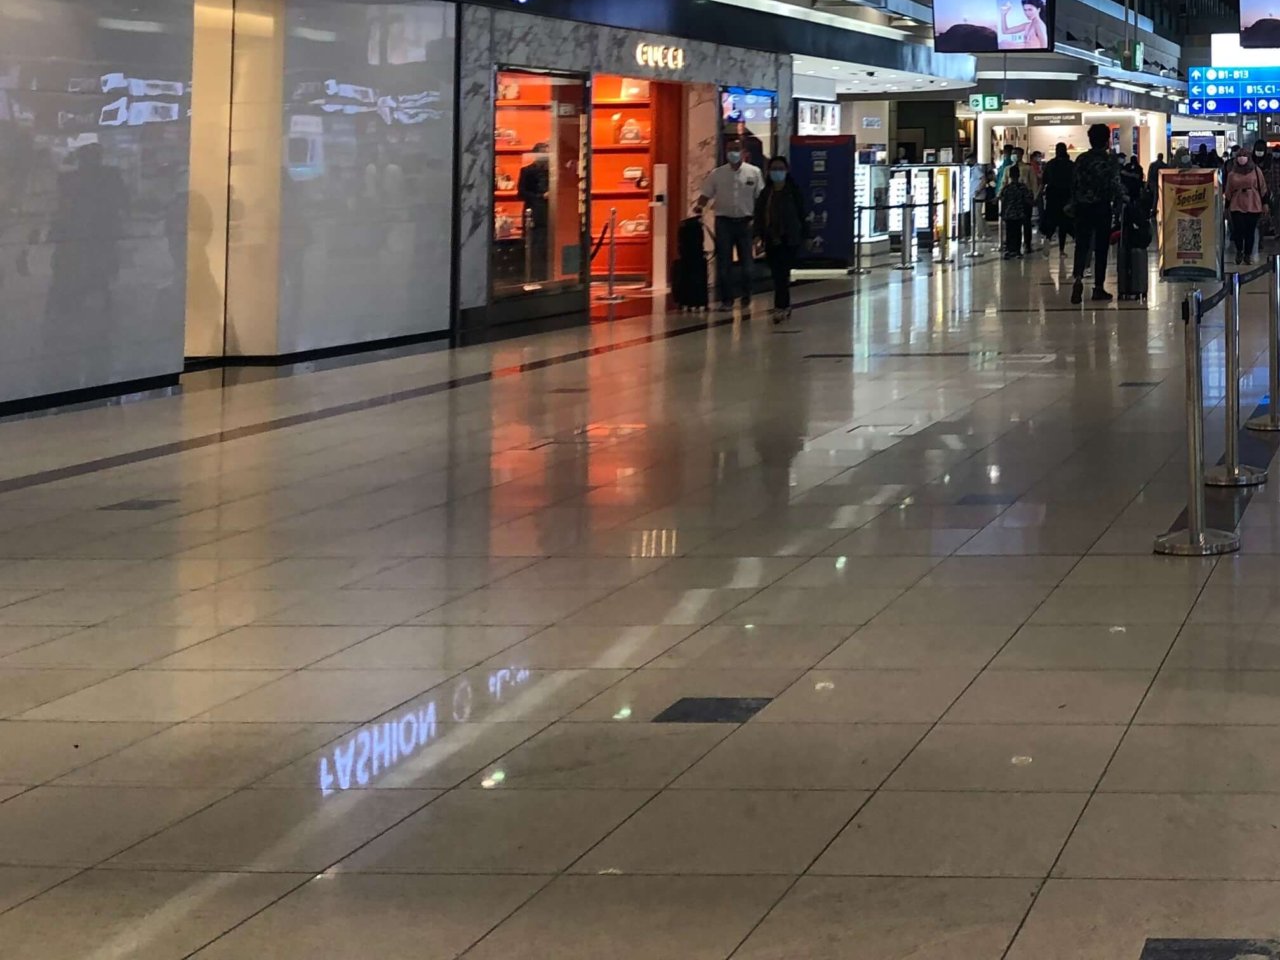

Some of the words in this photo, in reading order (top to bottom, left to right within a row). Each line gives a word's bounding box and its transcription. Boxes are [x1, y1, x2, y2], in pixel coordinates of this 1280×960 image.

[636, 42, 685, 70] GUCCI
[1218, 86, 1234, 94] B14
[1176, 188, 1206, 206] Special
